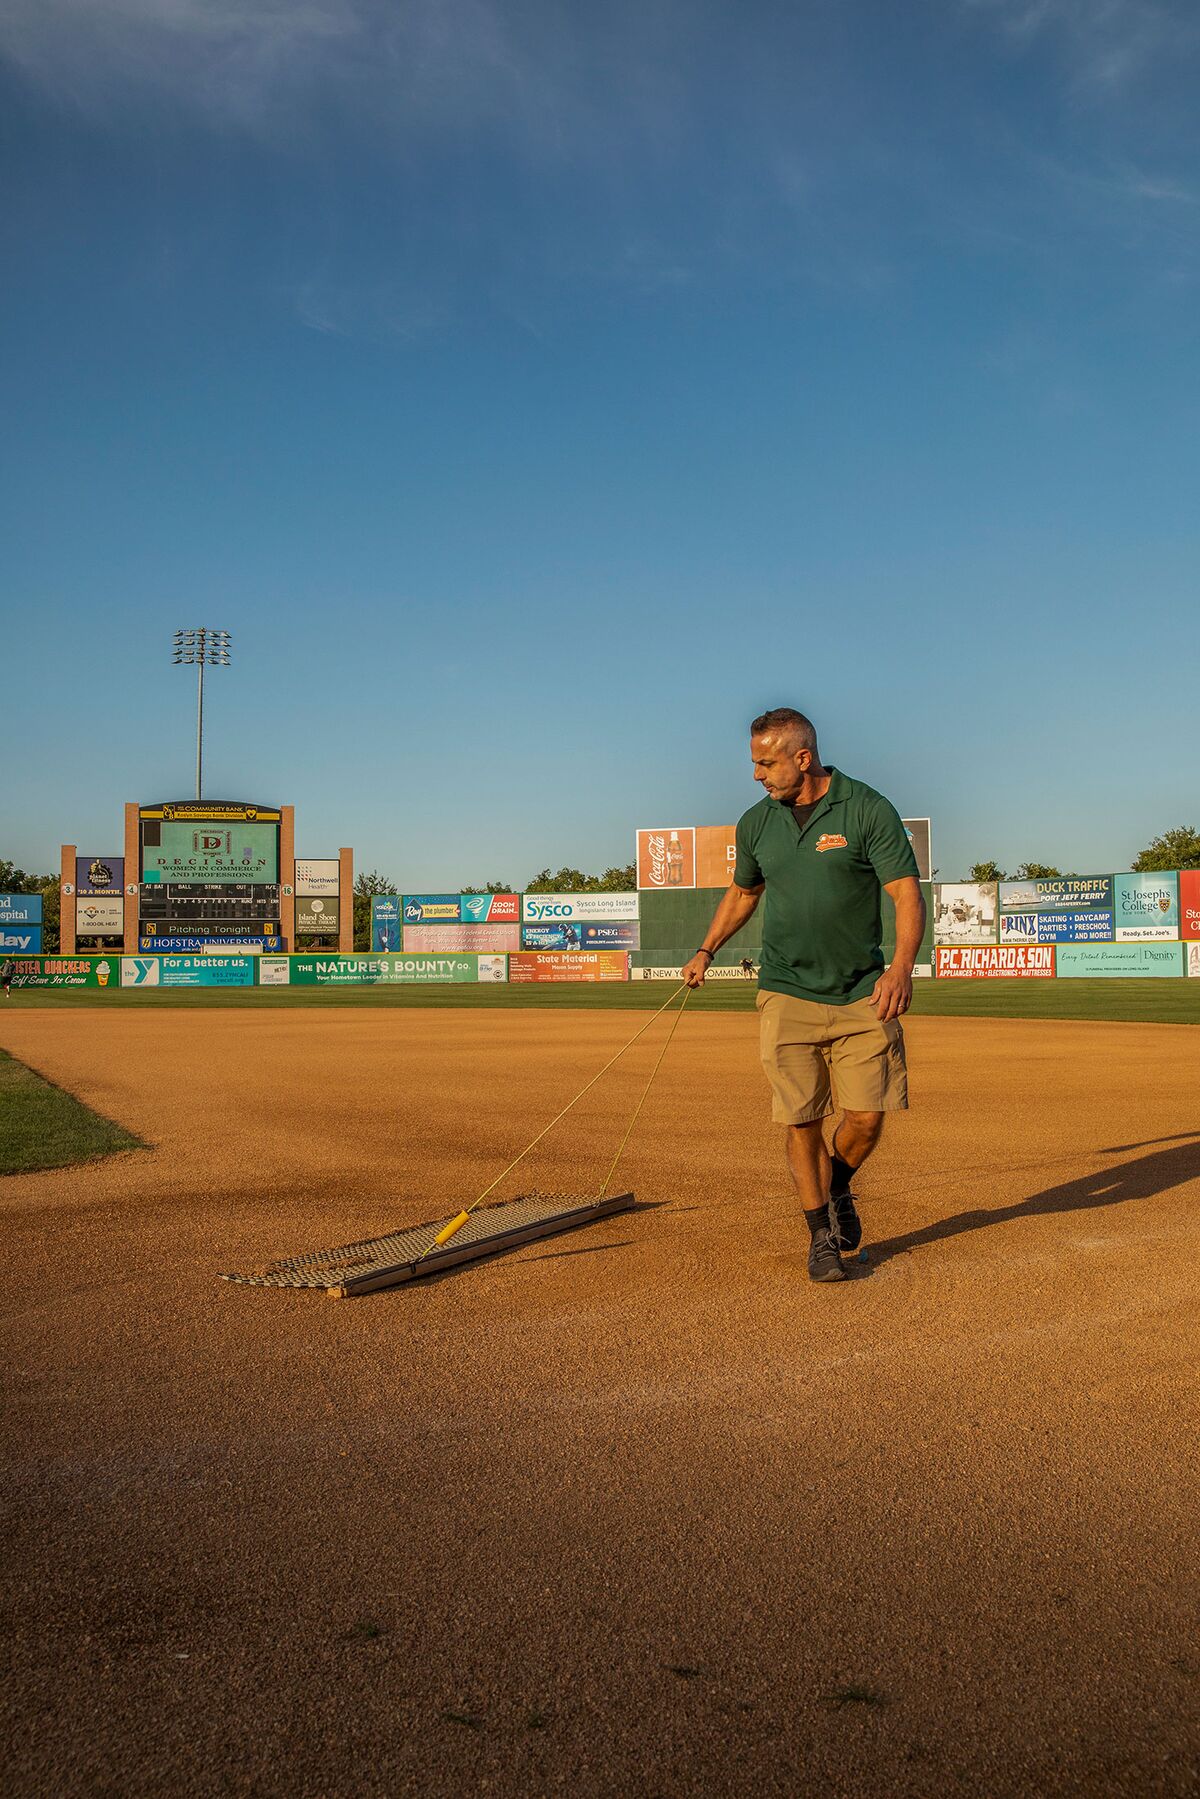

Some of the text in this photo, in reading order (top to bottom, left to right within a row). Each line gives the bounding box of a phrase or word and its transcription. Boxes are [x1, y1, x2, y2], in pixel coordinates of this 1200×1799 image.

[1037, 880, 1108, 893] DUCK TRAFFIC
[1122, 889, 1170, 902] St. Joseph's
[407, 906, 422, 920] Ray
[434, 906, 454, 915] plumber
[527, 902, 573, 920] Sysco
[1122, 902, 1158, 913] College
[169, 926, 250, 934] Pitching Tonight
[1006, 916, 1036, 936] RINX
[154, 938, 201, 948] HOFSTRA
[537, 954, 598, 963] State Material
[960, 948, 1016, 968] RICHARD
[1016, 948, 1026, 968] &
[1027, 947, 1052, 968] SON
[1062, 953, 1077, 962] Every
[1101, 952, 1136, 960] Remembered
[1144, 950, 1174, 961] Dignity
[14, 960, 91, 974] ISTER QUACKERS
[163, 958, 181, 967] For
[194, 958, 229, 967] better
[316, 960, 389, 972] NATURE'S
[395, 961, 456, 972] BOUNTY
[11, 976, 28, 987] Soft
[28, 976, 48, 984] Serve
[64, 976, 86, 984] Cream
